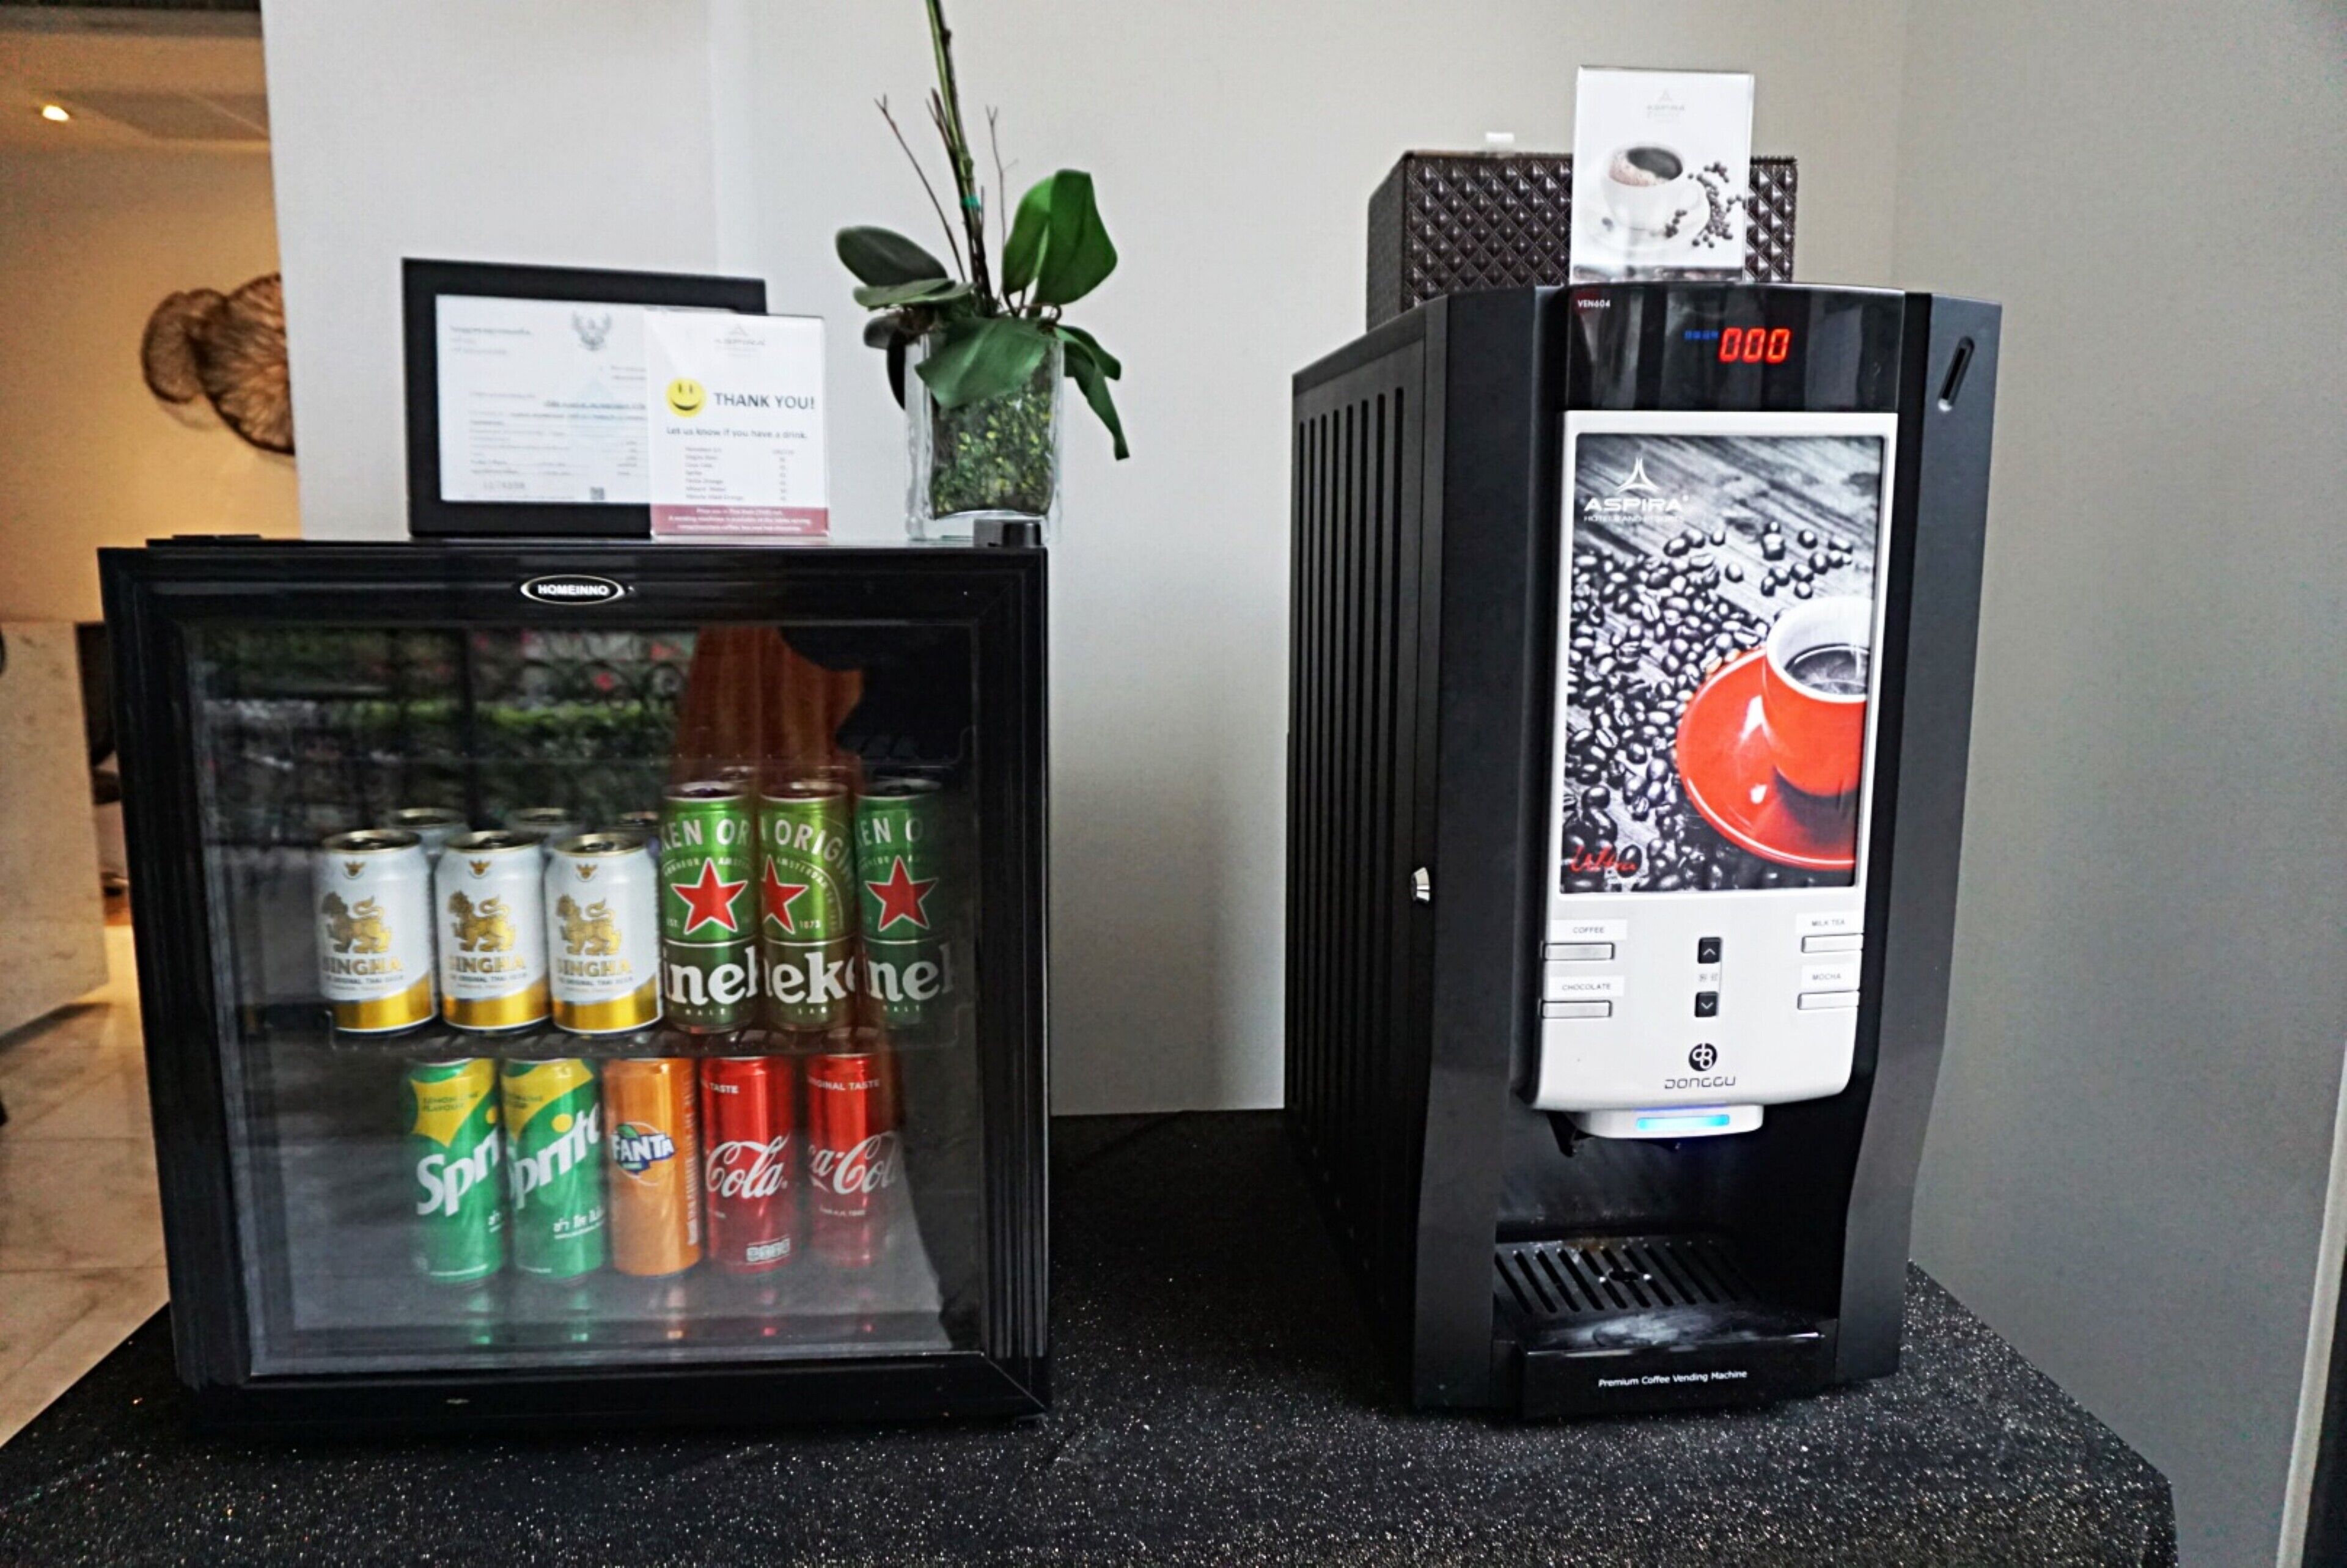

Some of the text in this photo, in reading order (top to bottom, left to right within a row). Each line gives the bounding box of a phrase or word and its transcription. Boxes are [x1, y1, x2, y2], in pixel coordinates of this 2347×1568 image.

[1578, 299, 1611, 308] VEN604
[1718, 326, 1791, 363] 000
[713, 392, 815, 409] THANK YOU!
[696, 428, 721, 436] know
[724, 428, 730, 436] if
[752, 429, 772, 438] have
[1584, 497, 1682, 512] ASPIRA
[538, 584, 610, 596] HOMEINNO
[710, 1082, 739, 1094] TASTE
[848, 1079, 881, 1091] TASTE
[612, 1132, 675, 1161] FANTA
[1598, 1371, 1747, 1388] Premium Coffee Vending Machine
